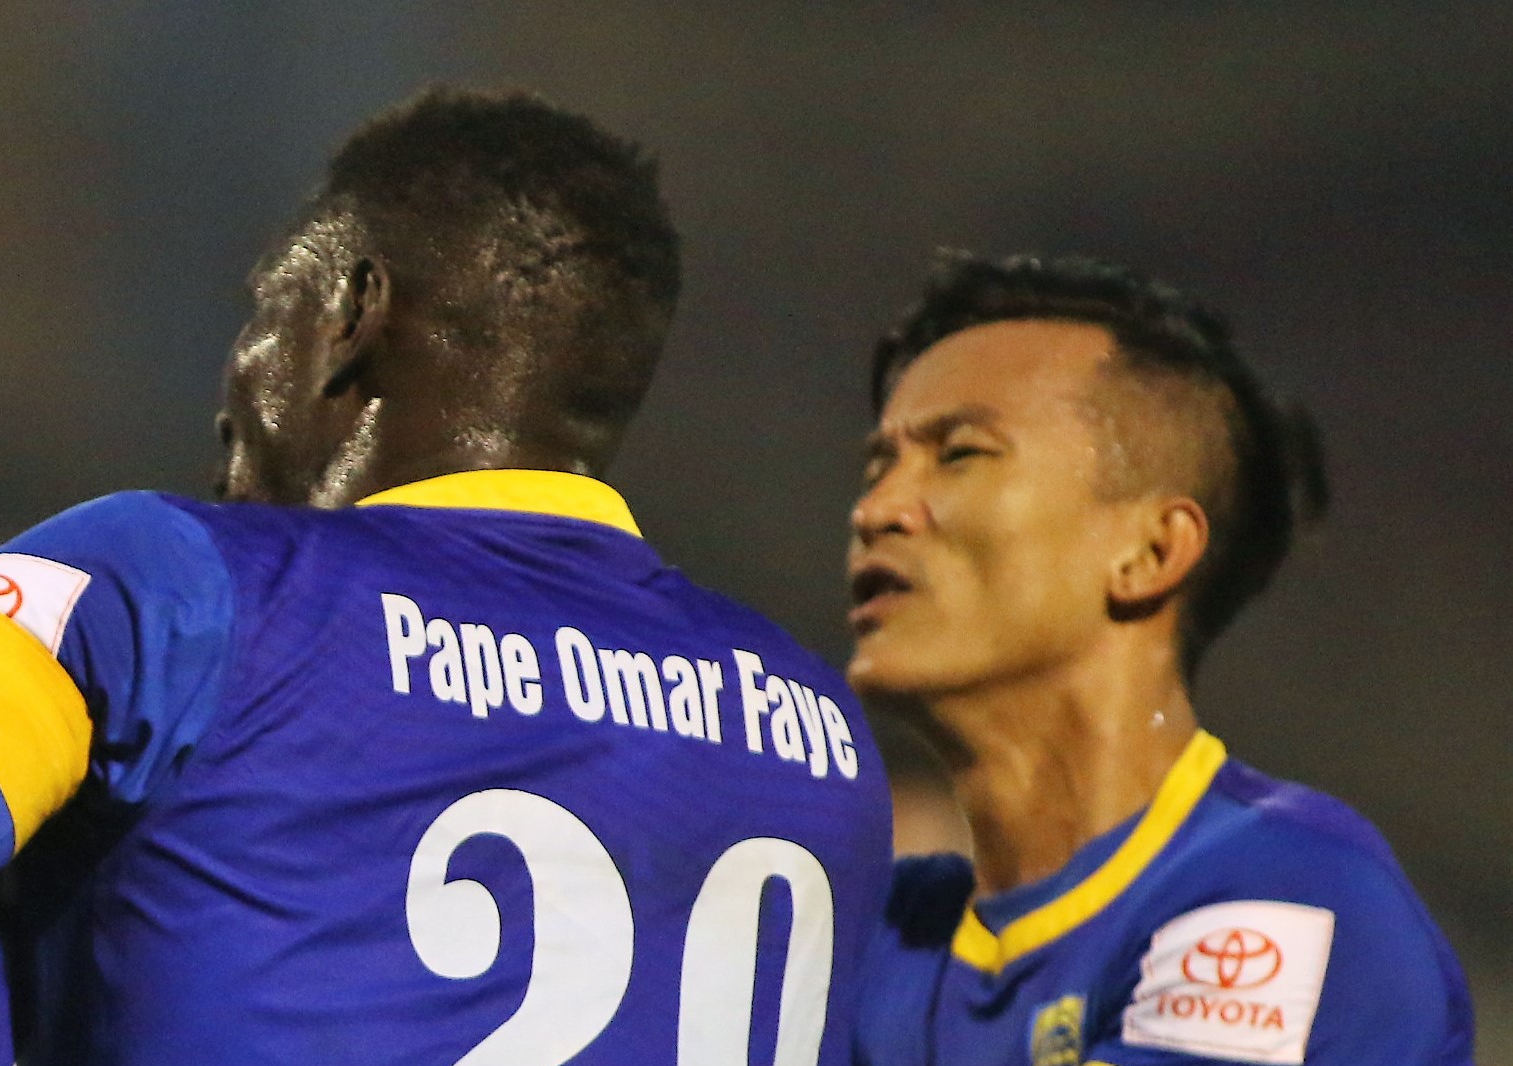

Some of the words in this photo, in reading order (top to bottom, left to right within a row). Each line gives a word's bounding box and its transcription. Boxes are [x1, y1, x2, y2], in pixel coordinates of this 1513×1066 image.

[381, 592, 544, 718] Pape
[554, 626, 724, 743] Omar
[731, 648, 860, 779] Faye
[1156, 993, 1285, 1032] TOYOTA
